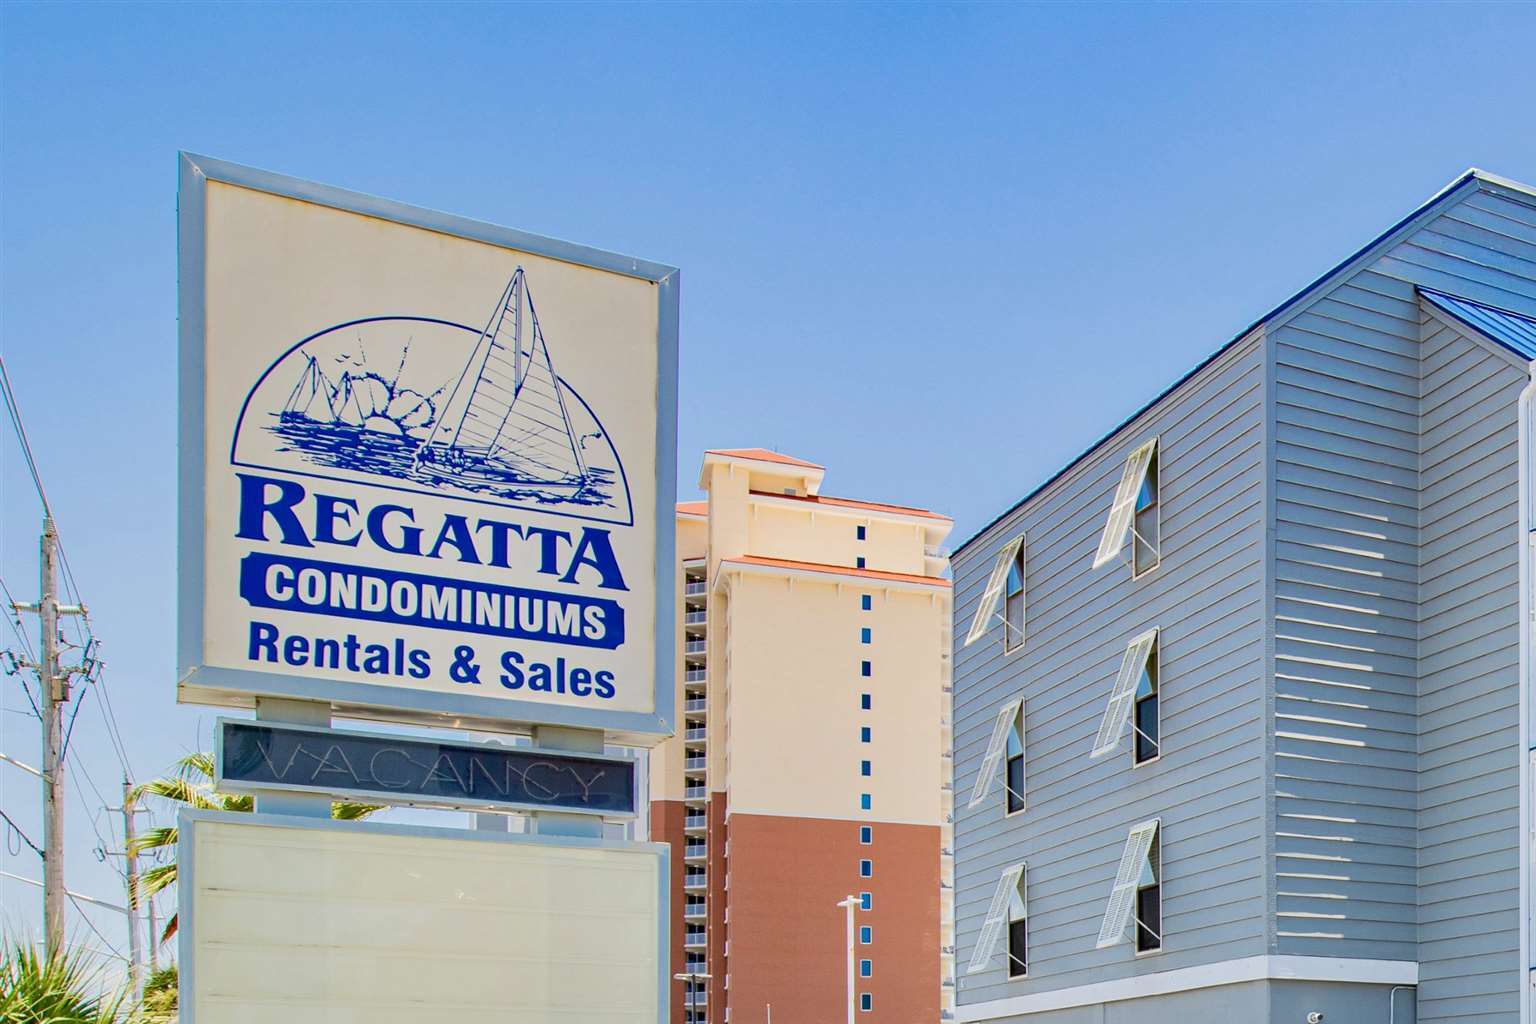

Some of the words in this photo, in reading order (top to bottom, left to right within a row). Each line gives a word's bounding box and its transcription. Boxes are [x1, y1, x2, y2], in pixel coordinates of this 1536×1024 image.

[234, 472, 630, 592] REGATTA
[264, 563, 607, 640] CONDOMINIUMS
[248, 621, 431, 679] Rentals
[449, 644, 481, 684] &
[500, 651, 616, 699] Sales
[256, 739, 606, 804] VACANCY
